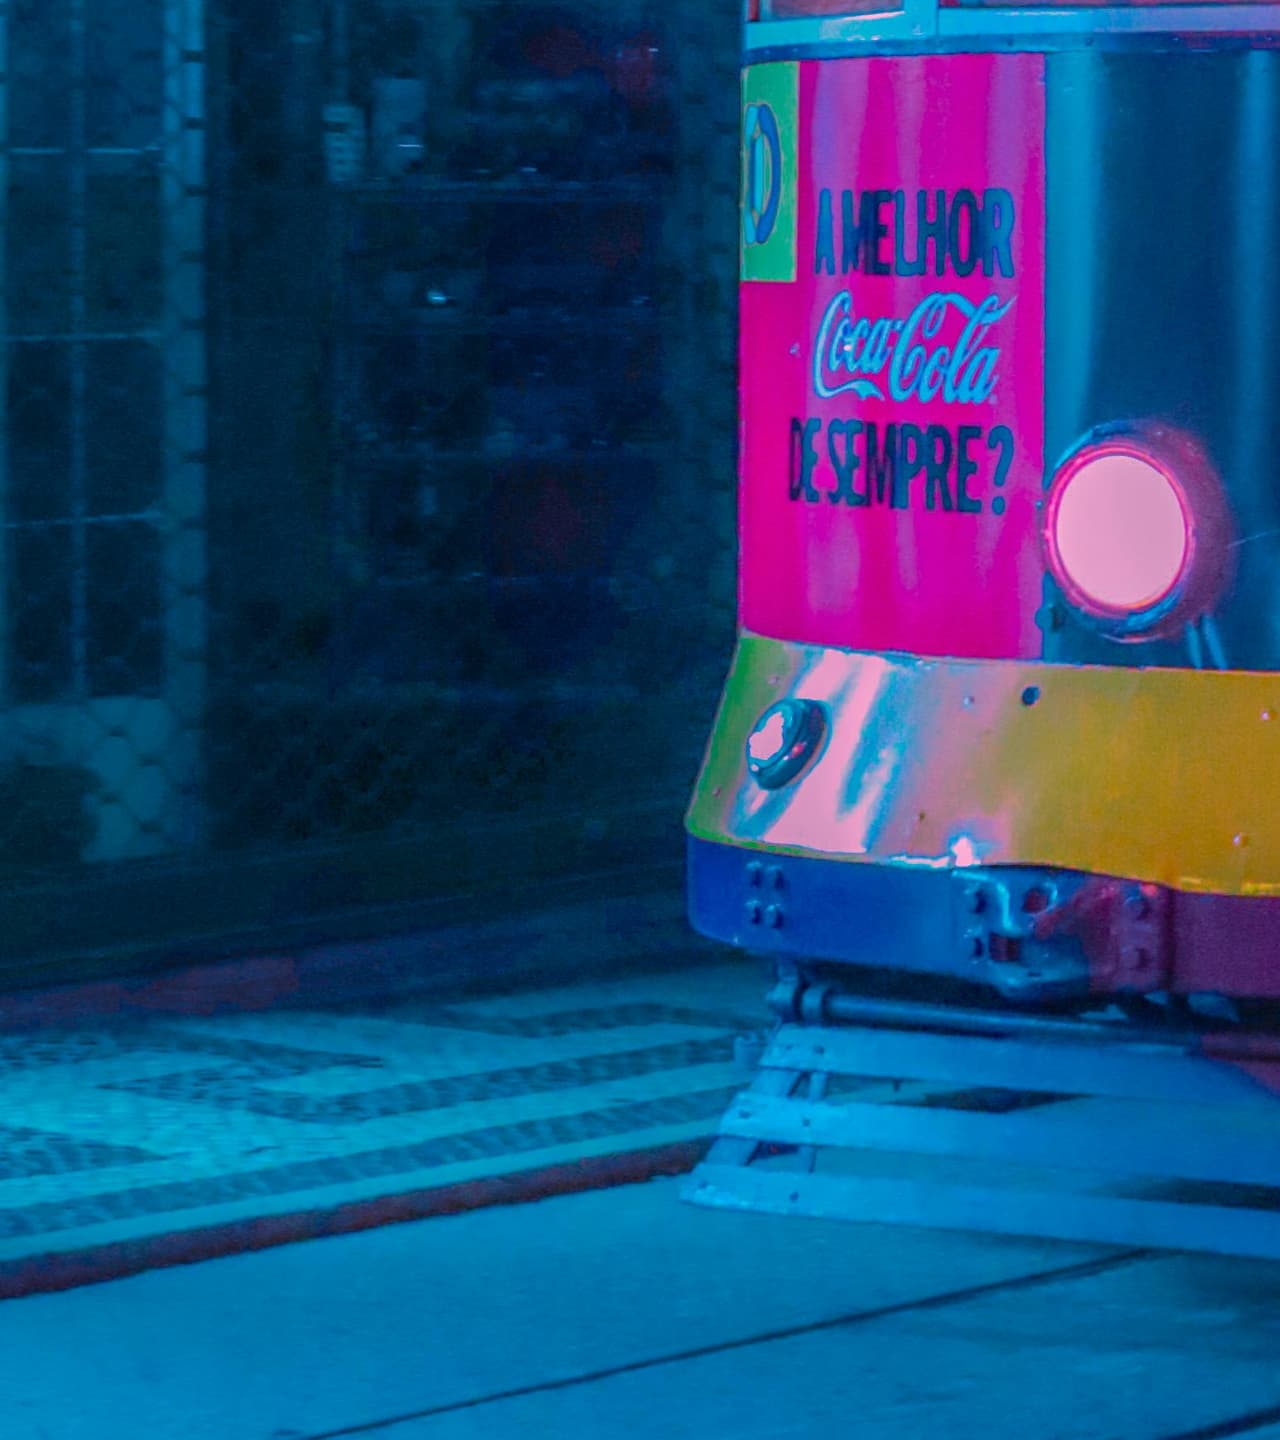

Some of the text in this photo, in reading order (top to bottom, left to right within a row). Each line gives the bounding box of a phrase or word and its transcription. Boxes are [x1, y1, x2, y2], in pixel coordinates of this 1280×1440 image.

[813, 187, 1016, 279] A MELHOR
[813, 289, 1018, 405] Coca-Cola
[788, 417, 1016, 517] DE SEMPRE?
